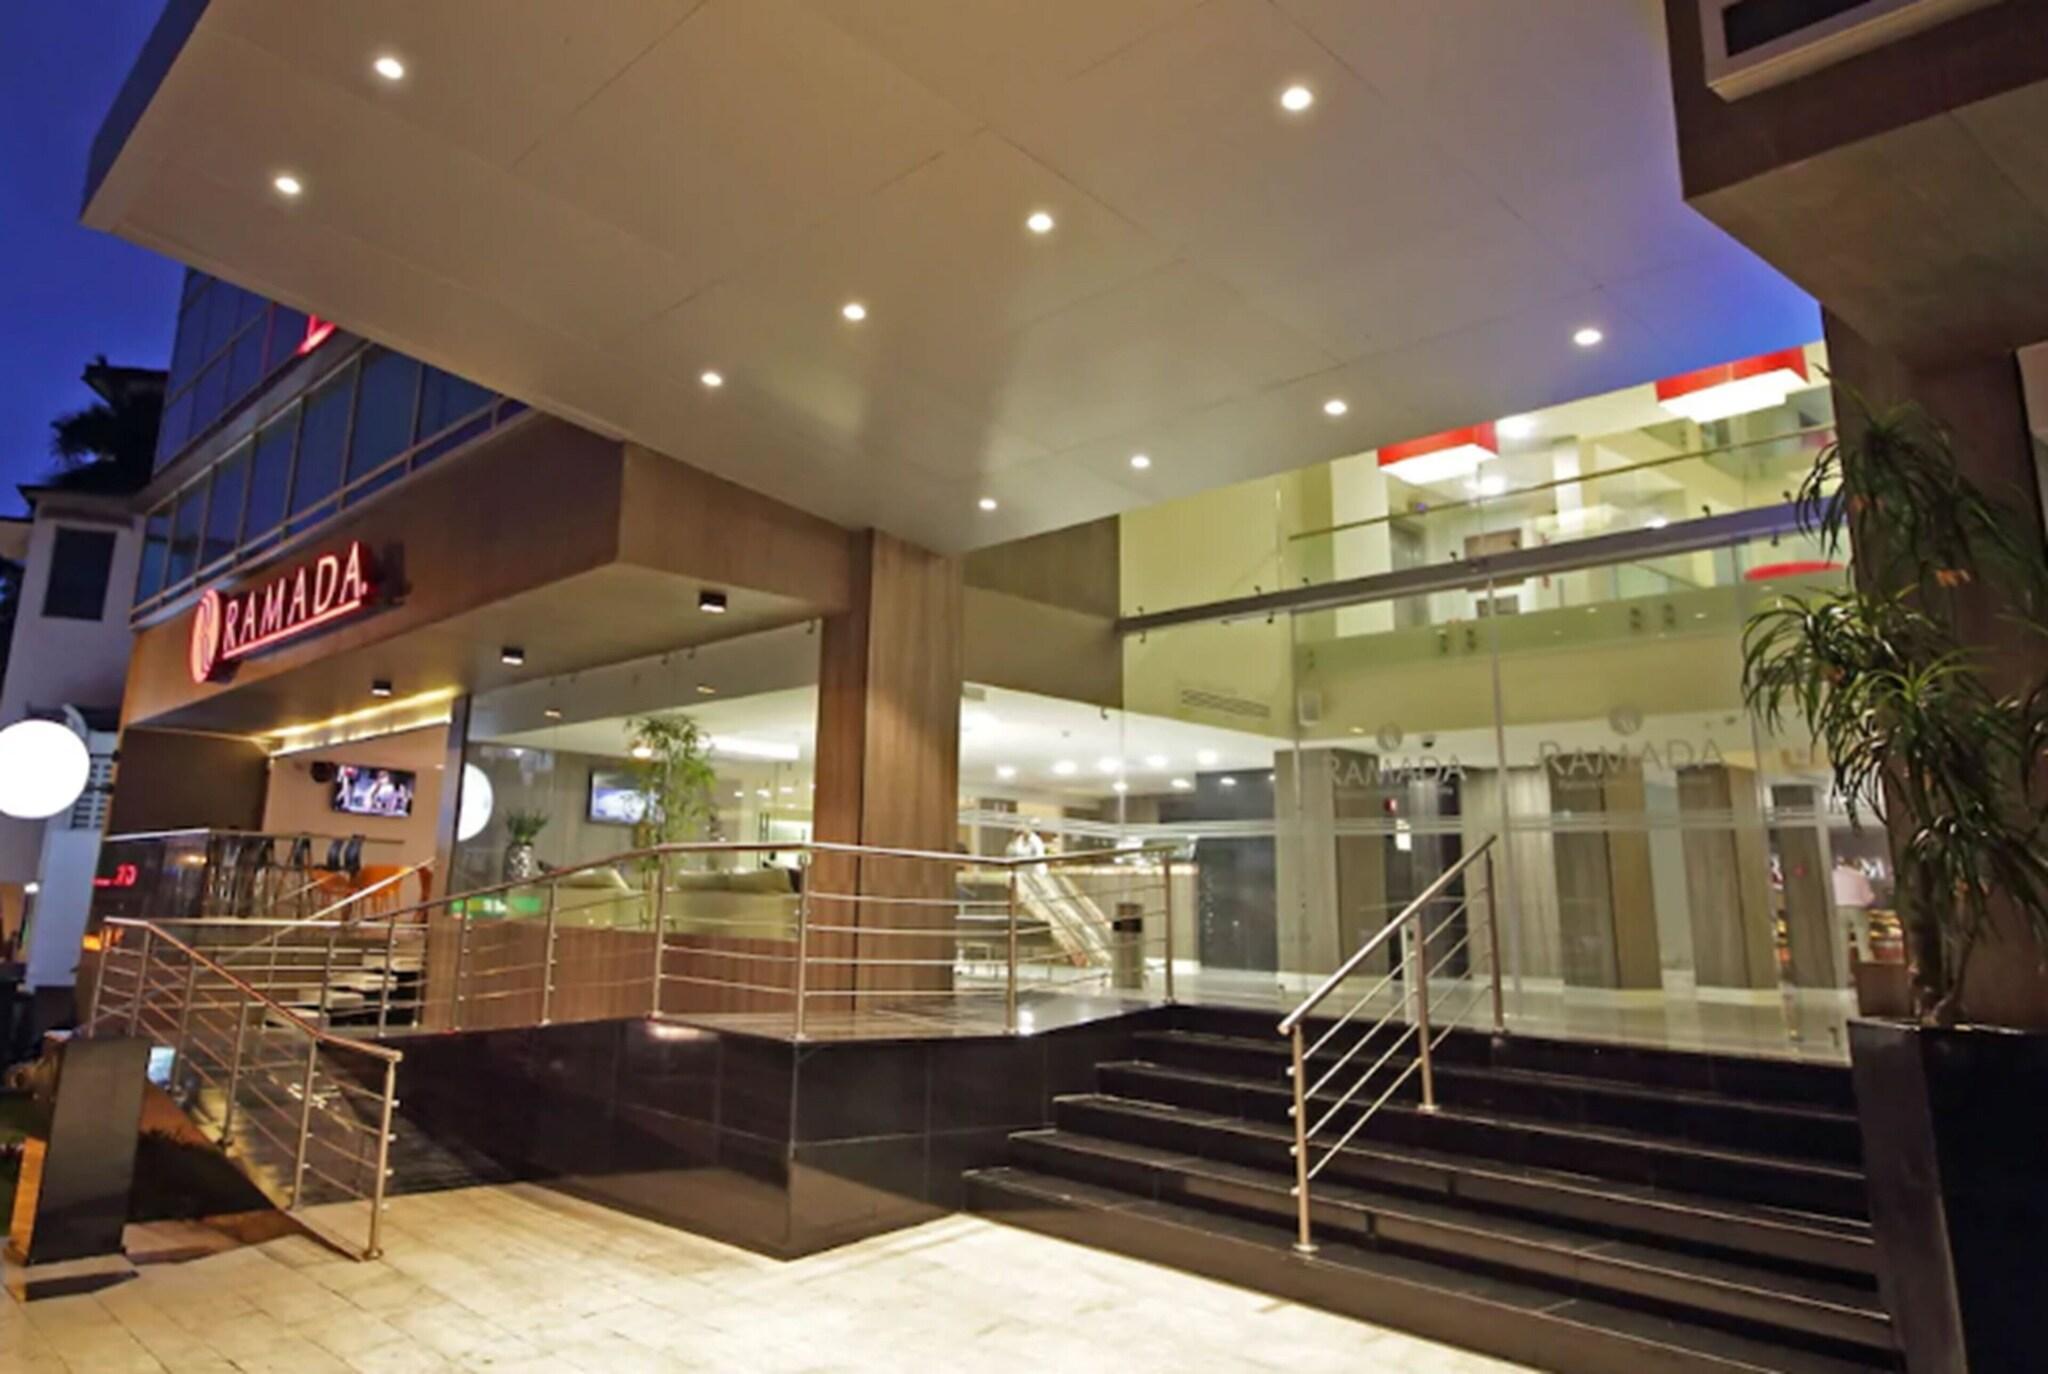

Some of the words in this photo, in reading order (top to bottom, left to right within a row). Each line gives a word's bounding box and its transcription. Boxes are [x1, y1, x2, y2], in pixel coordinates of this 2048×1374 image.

[222, 541, 362, 651] RAMADA
[1324, 754, 1468, 787] RAMADA
[1538, 737, 1728, 776] RAMADA
